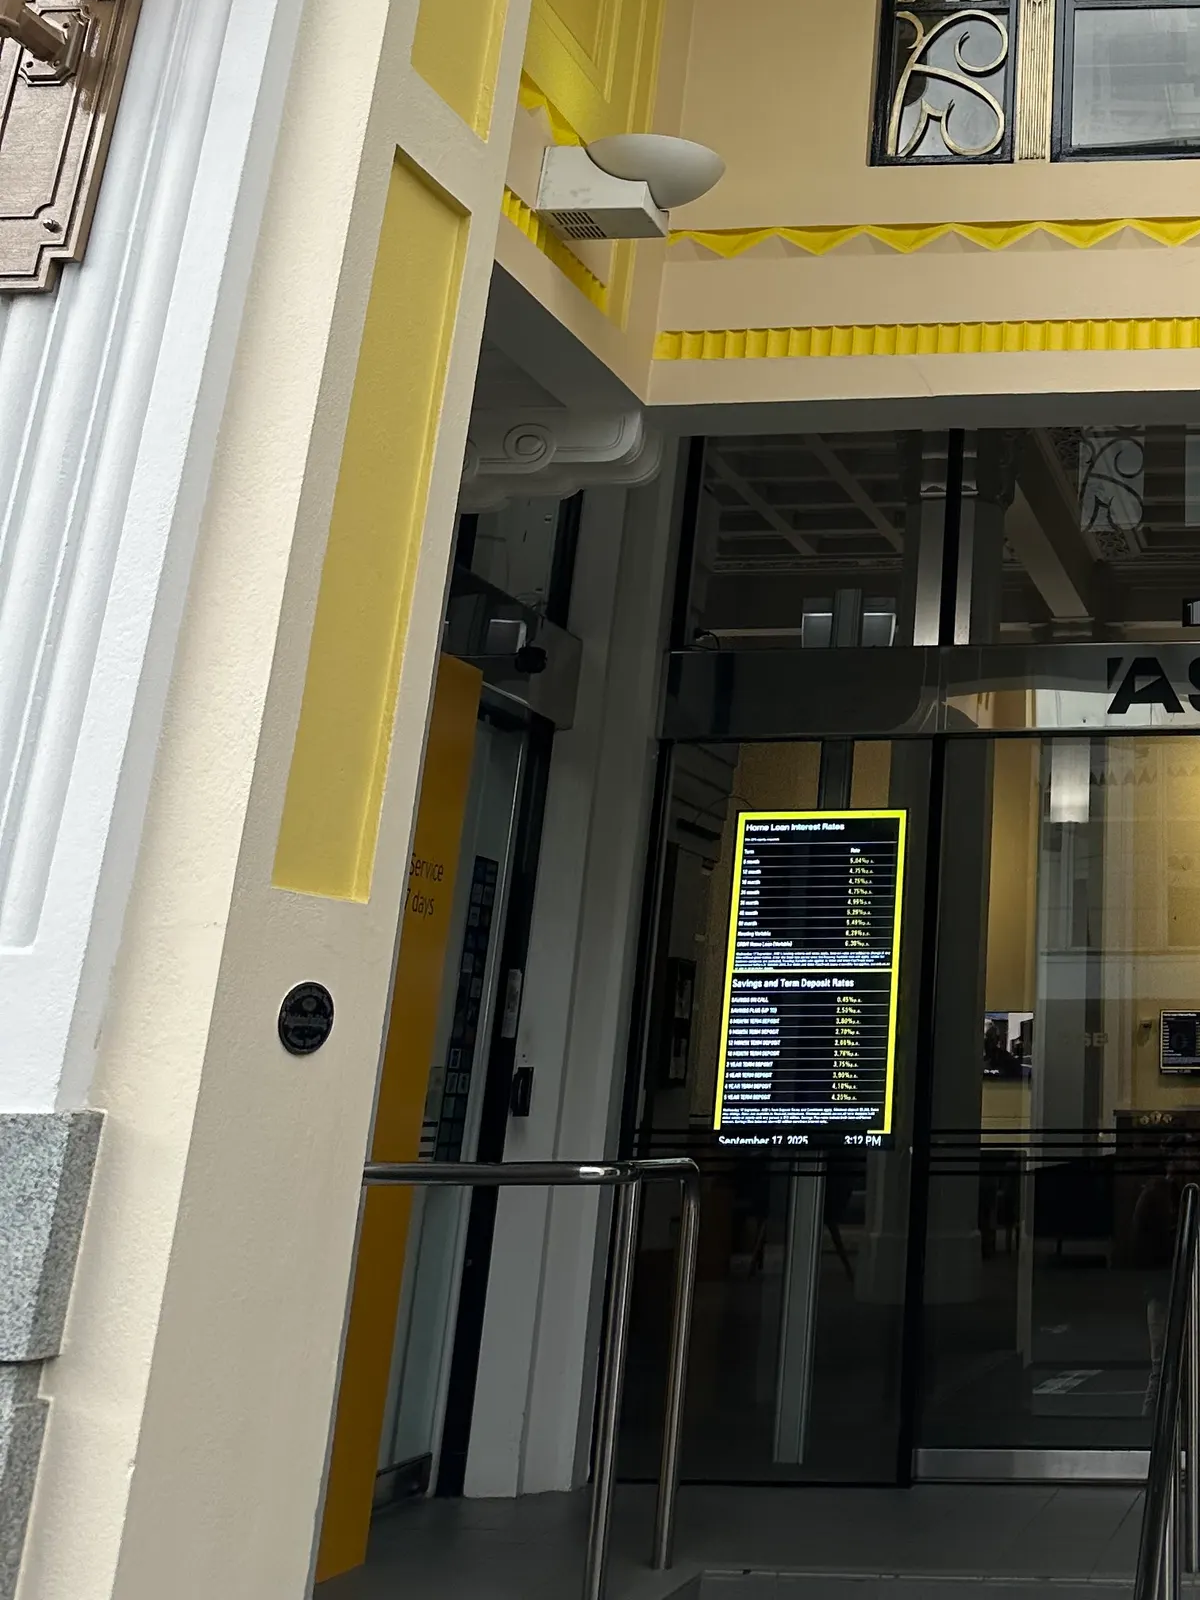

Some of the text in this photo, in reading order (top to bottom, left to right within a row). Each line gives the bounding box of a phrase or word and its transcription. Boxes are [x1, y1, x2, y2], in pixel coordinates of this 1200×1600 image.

[746, 824, 769, 832] Home
[410, 852, 444, 882] Service
[412, 890, 434, 920] days
[732, 978, 854, 989] Savings and Term Deposit Rates
[866, 1136, 881, 1146] PM
